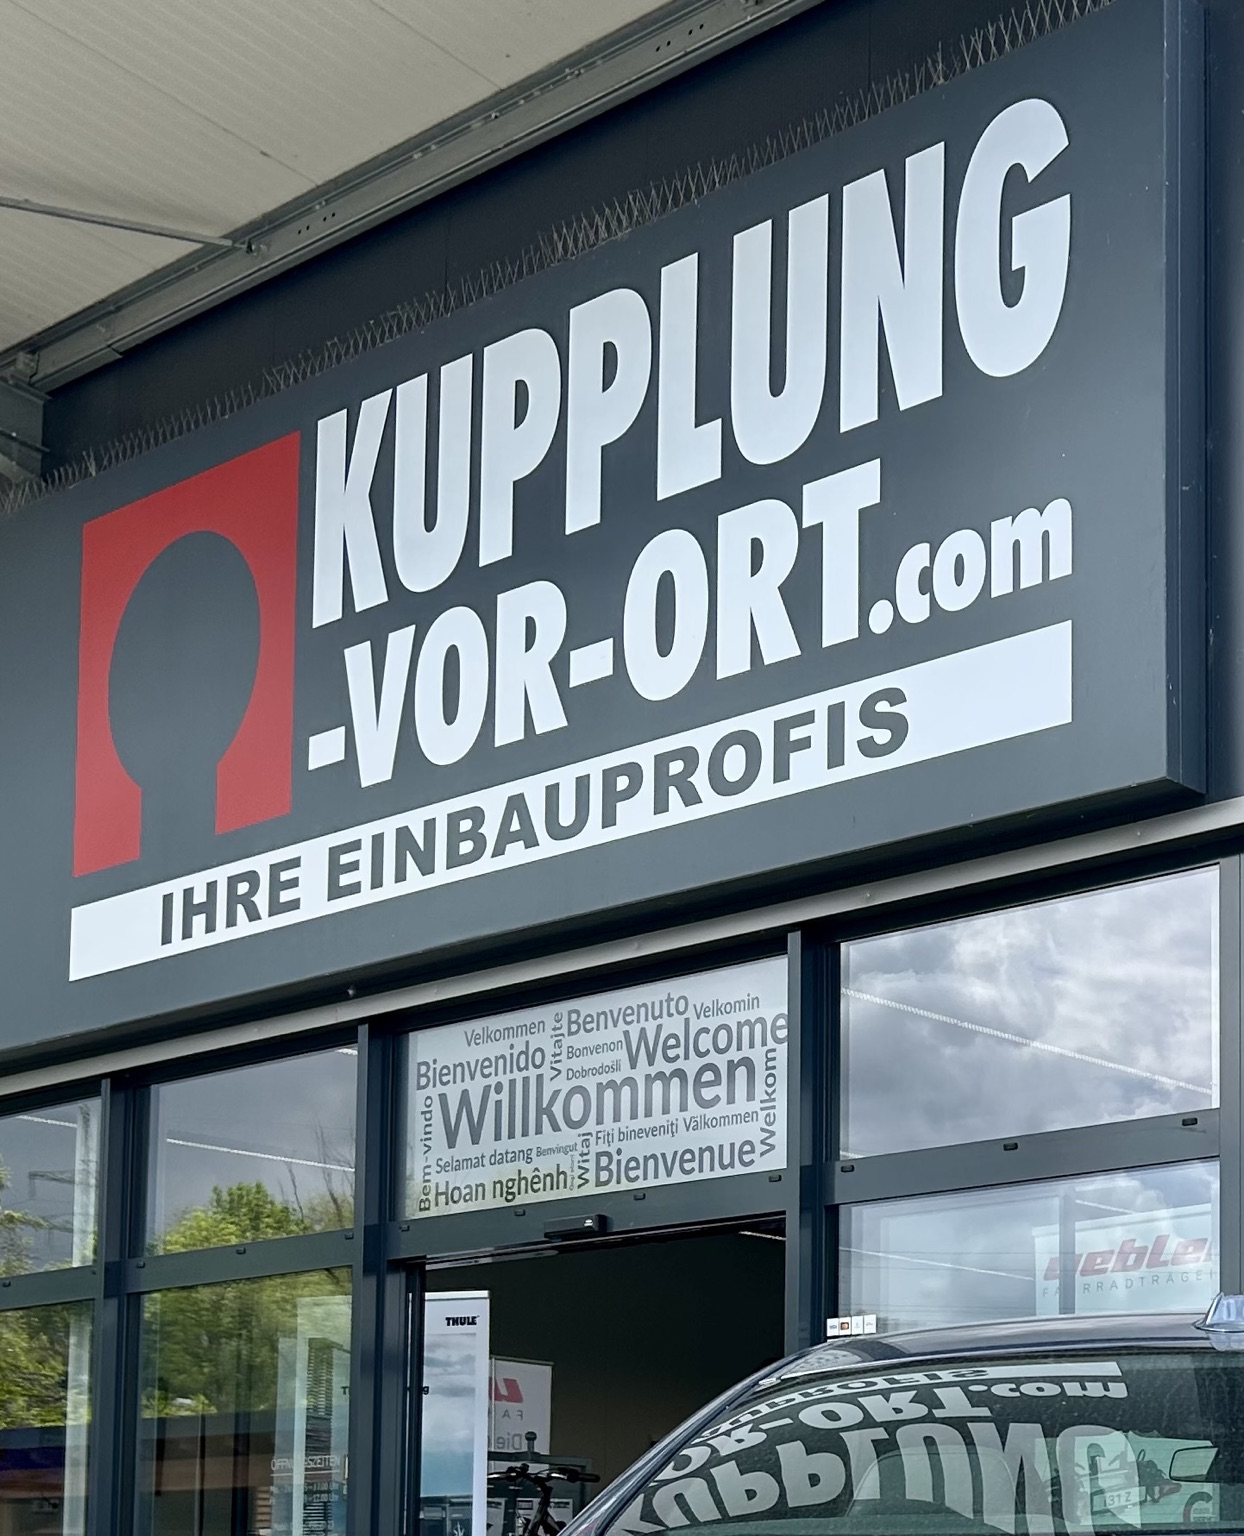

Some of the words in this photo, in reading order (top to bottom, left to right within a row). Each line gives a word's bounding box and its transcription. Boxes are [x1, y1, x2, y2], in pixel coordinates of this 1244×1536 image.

[310, 96, 1072, 627] KUPPLUNG
[308, 459, 1073, 787] -VOR-ORT.com
[160, 856, 301, 945] IHRE
[326, 685, 910, 901] EINBAUPROFIS
[566, 993, 689, 1037] Benvenuto
[692, 993, 760, 1020] Velkomin
[464, 1018, 545, 1048] Velkommen
[549, 1011, 566, 1082] Vitajte
[566, 1038, 623, 1060] Bonvenon
[623, 1012, 788, 1070] Welcome
[416, 1040, 546, 1091] Bienvenido
[566, 1058, 622, 1081] Dobrodošli
[438, 1056, 756, 1150] Willkommen
[760, 1048, 777, 1158] Welkom
[419, 1095, 434, 1212] Bem-vindo
[435, 1152, 486, 1175] Selamat
[489, 1147, 534, 1166] datang
[594, 1139, 756, 1188] Bienvenue
[434, 1180, 486, 1208] Hoan
[492, 1163, 568, 1203] nghênh
[445, 1315, 478, 1327] THULE
